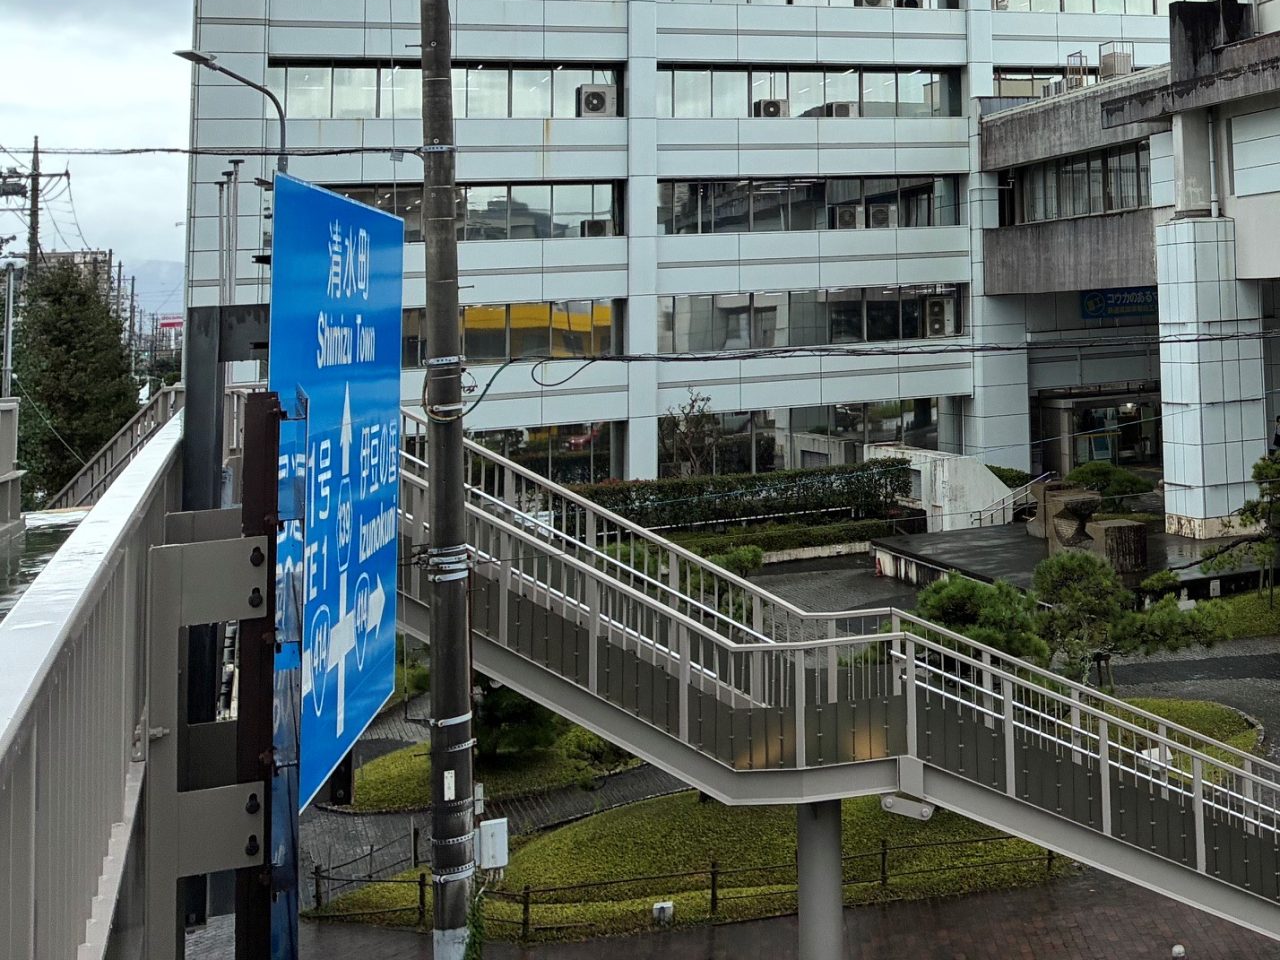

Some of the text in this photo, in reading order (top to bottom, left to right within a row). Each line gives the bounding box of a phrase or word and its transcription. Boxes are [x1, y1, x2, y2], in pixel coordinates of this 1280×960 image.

[327, 219, 370, 300] 清水町
[317, 310, 376, 369] Shimizu Town
[360, 421, 397, 500] 伊豆の国
[359, 494, 396, 564] Izunokuni
[314, 621, 327, 675] 414
